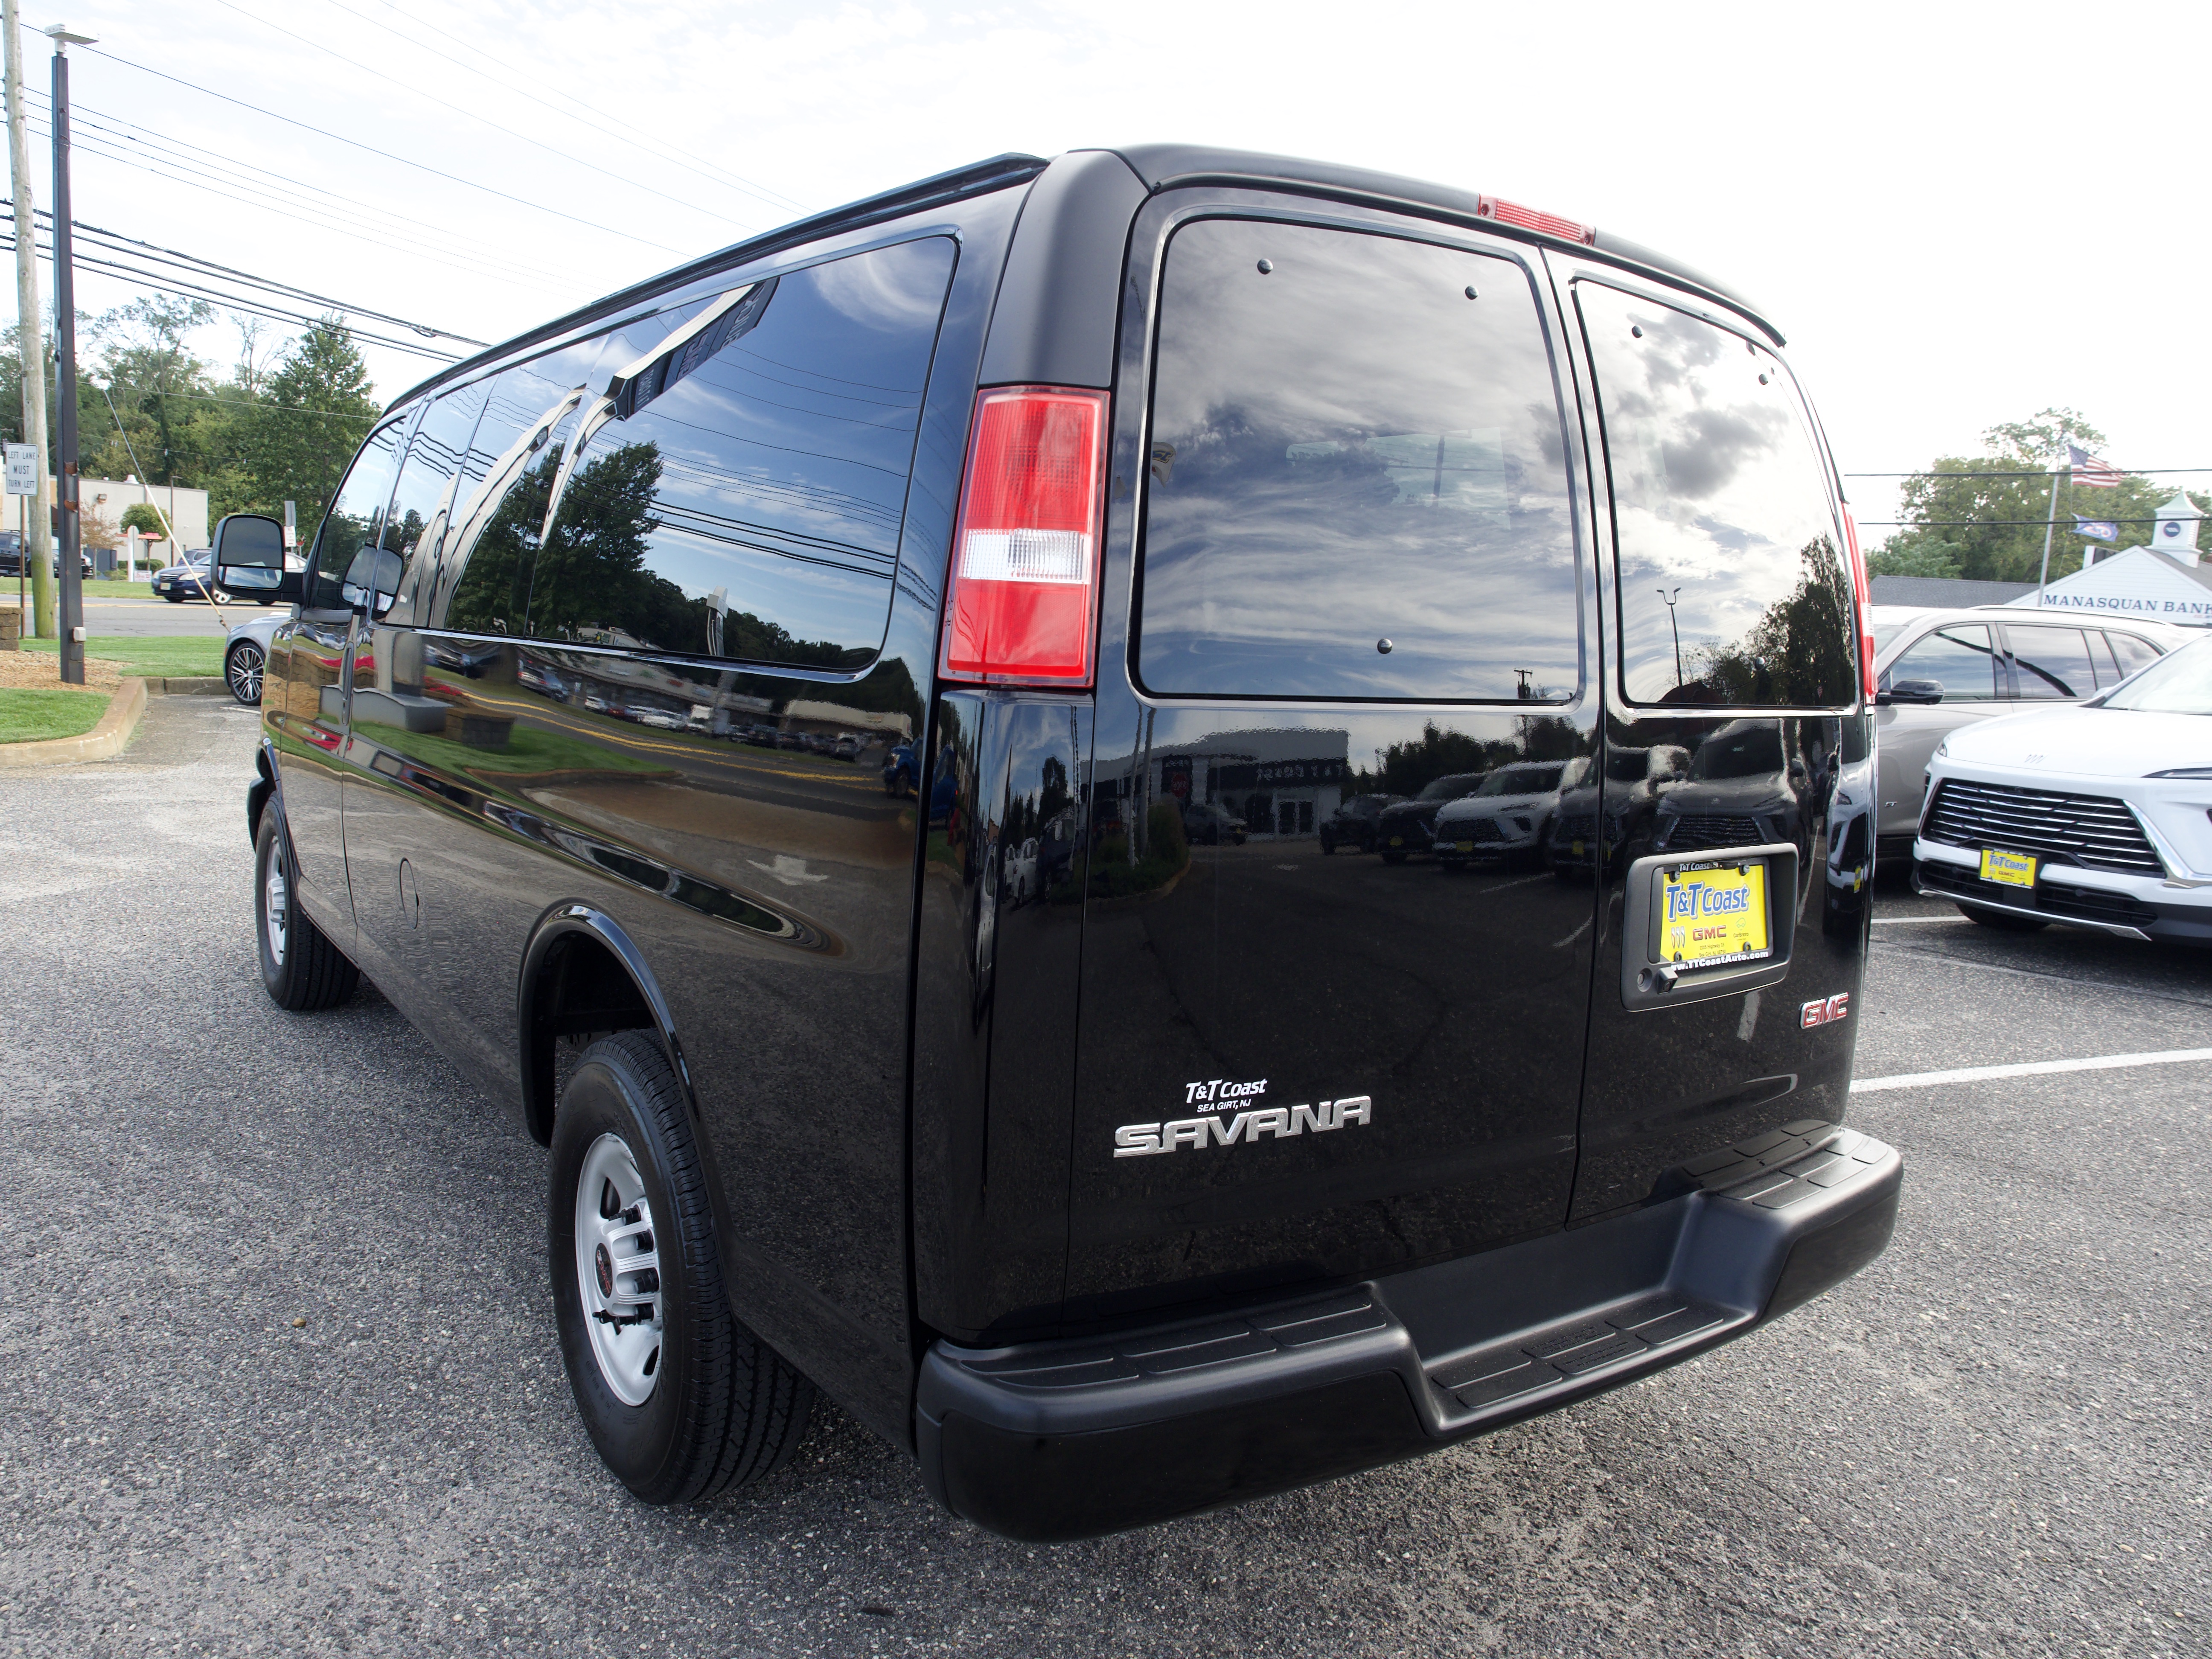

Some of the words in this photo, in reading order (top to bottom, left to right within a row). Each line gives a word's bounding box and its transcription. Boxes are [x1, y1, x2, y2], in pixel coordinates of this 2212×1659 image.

[13, 465, 29, 474] MUST
[2043, 595, 2159, 610] MANASQUAN
[2163, 601, 2212, 614] BANK
[1679, 863, 1691, 872] T&T
[1691, 862, 1710, 871] Coast
[1989, 855, 2005, 867] T&T
[2005, 859, 2029, 871] Coast
[1666, 881, 1704, 922] T&T
[1701, 884, 1749, 916] Coast
[1693, 925, 1727, 941] GMC
[1800, 992, 1849, 1029] GMC
[1186, 1079, 1222, 1103] T&T
[1220, 1078, 1267, 1098] Coast
[1197, 1103, 1215, 1113] SEA
[1217, 1100, 1238, 1110] GIRT,
[1239, 1098, 1251, 1107] NJ
[1113, 1096, 1371, 1158] SAVANA
